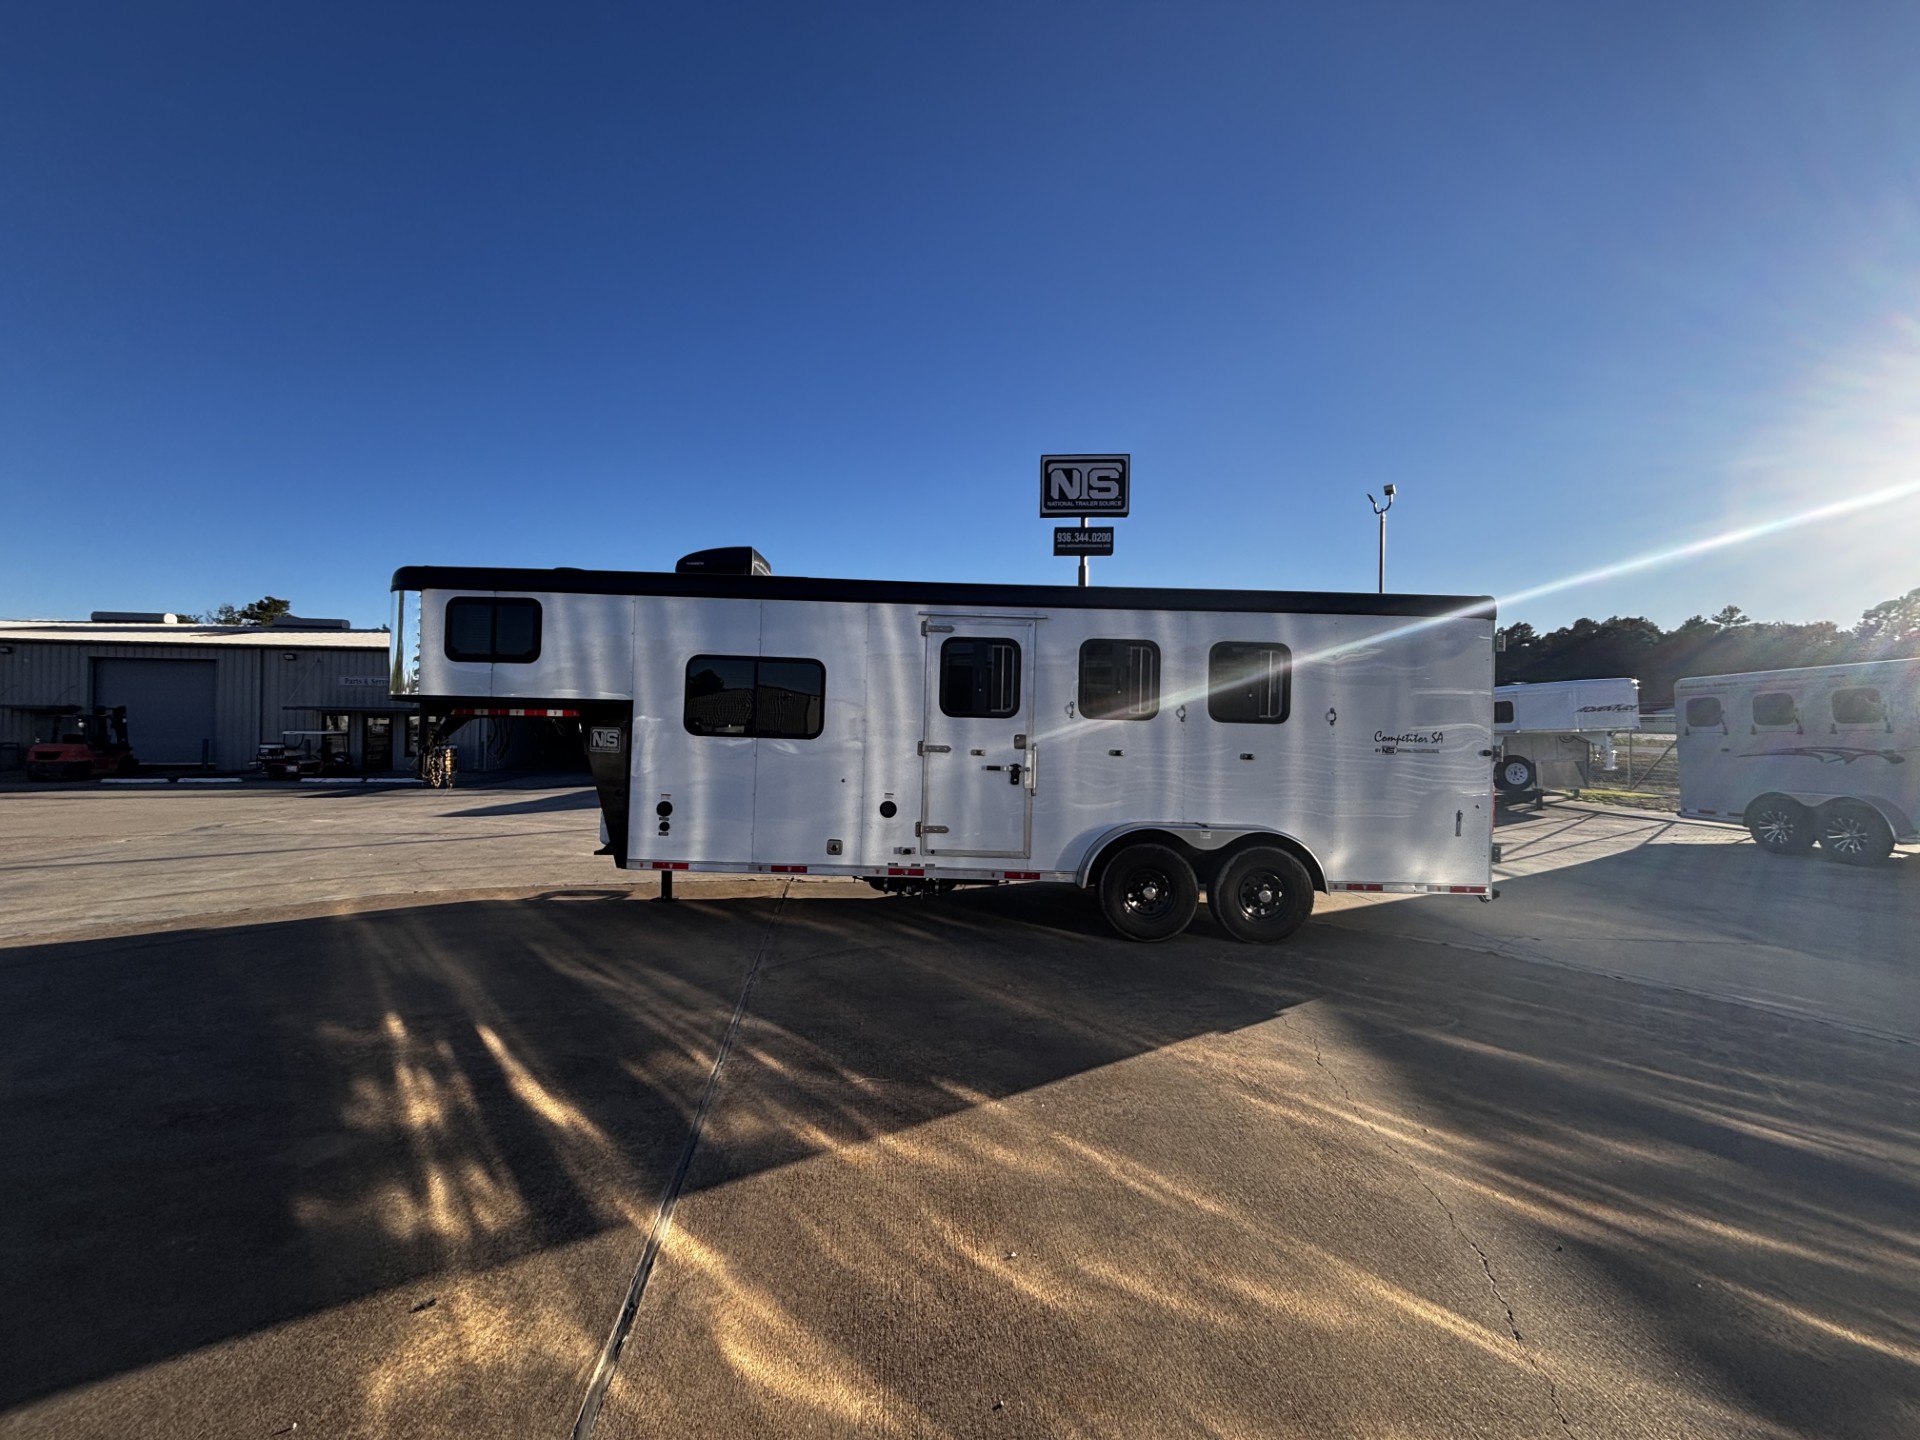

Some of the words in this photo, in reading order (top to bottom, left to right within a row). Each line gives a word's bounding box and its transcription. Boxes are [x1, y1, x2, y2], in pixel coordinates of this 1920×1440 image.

[1047, 462, 1123, 500] NTS
[1057, 532, 1112, 542] 936.344.0200
[592, 728, 620, 747] NTS
[1374, 730, 1428, 746] Competitor
[1431, 731, 1444, 744] SA
